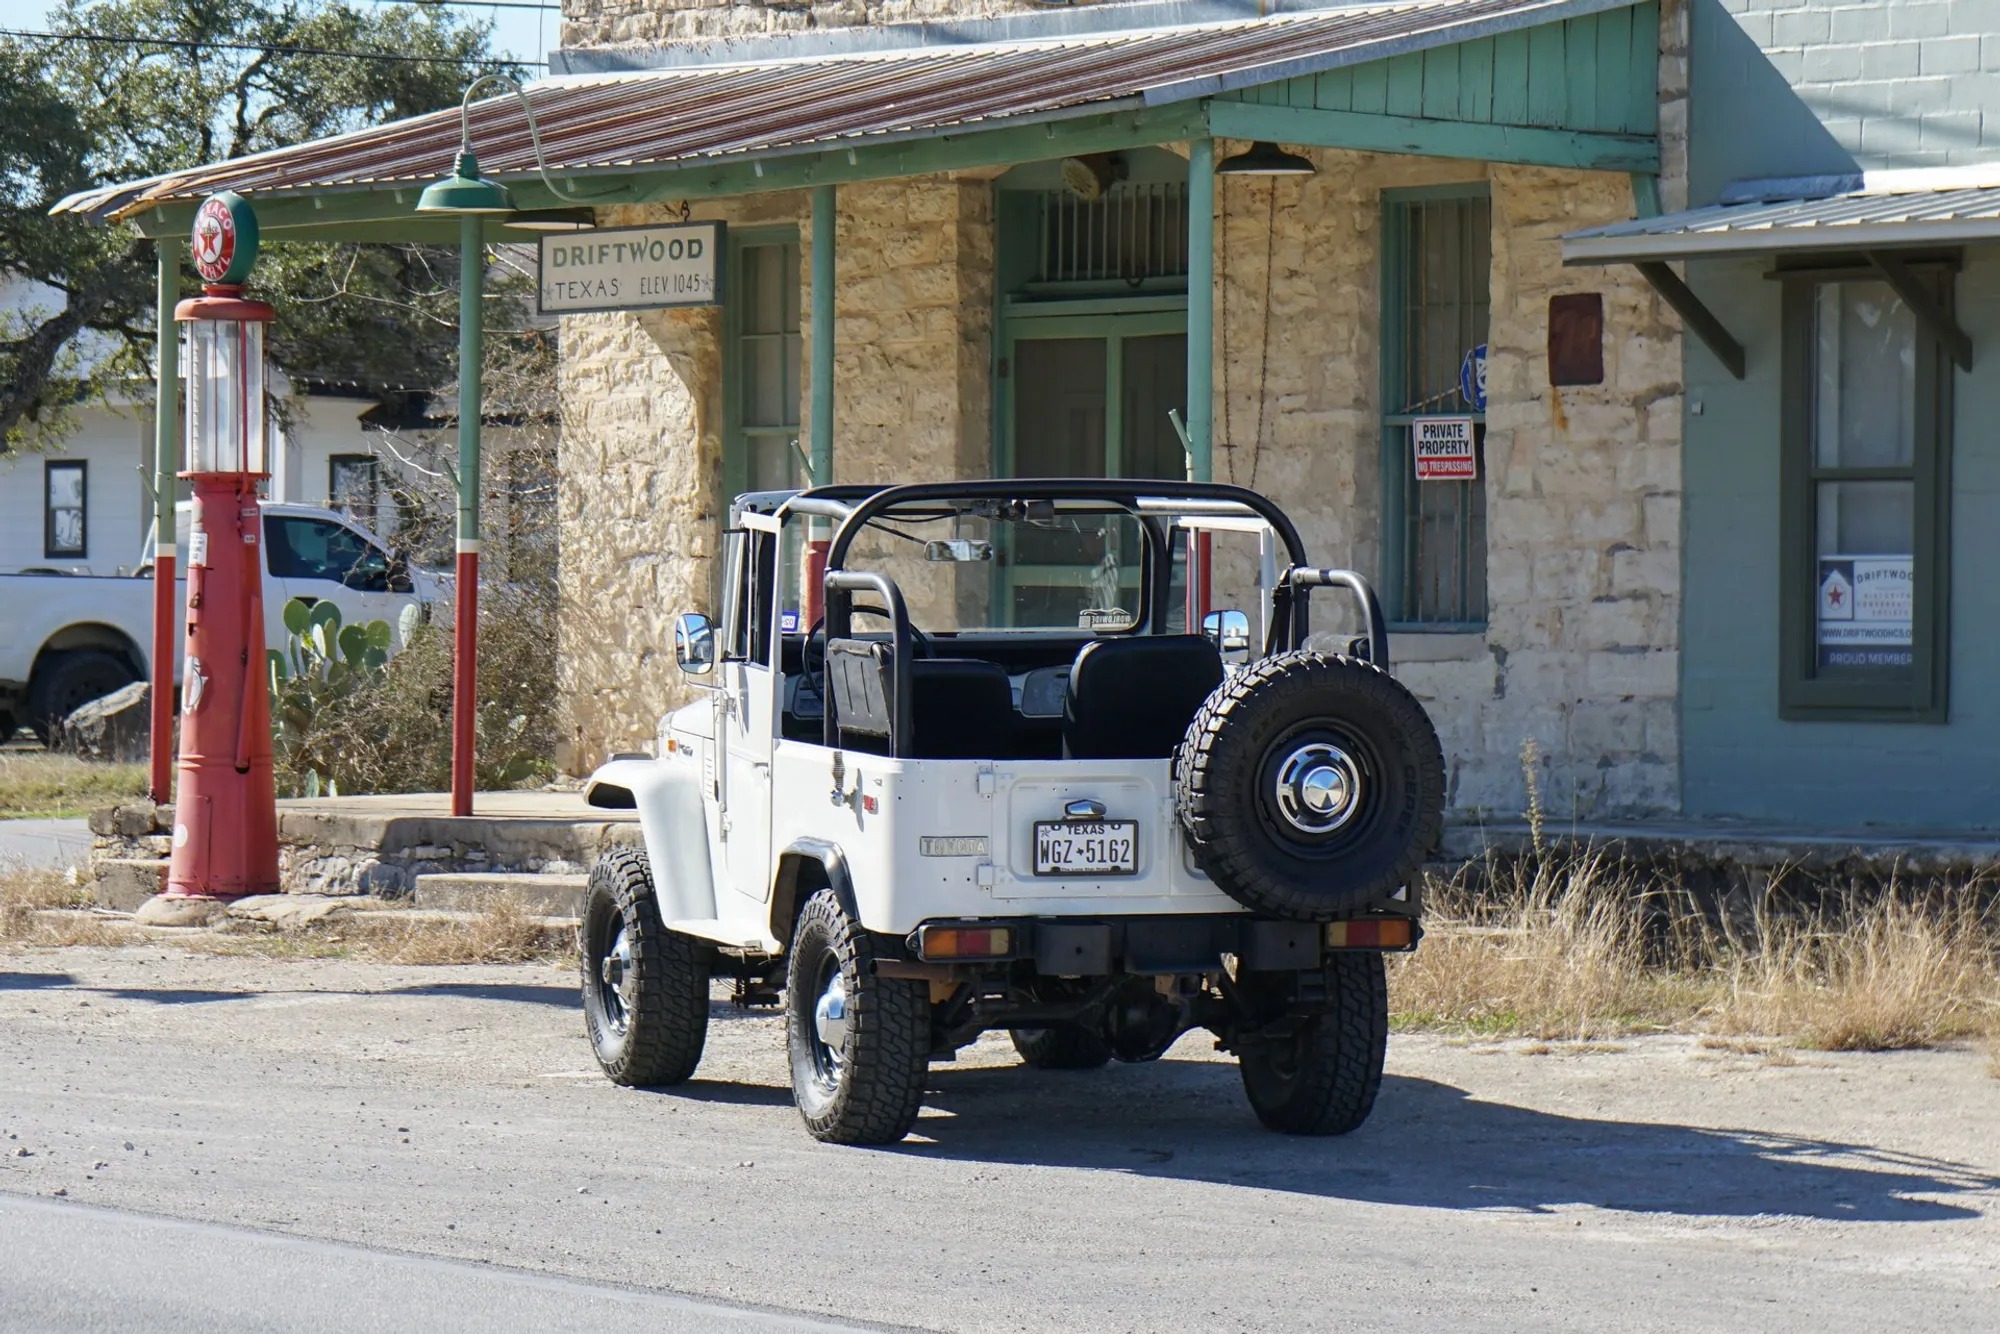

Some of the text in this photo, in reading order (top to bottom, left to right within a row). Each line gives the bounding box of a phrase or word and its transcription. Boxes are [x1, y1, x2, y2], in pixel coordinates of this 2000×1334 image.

[552, 236, 704, 268] DRIFTWOOD
[555, 273, 700, 300] TEXAS ELEV. 1045
[1423, 424, 1464, 438] PRIVATE
[1419, 440, 1469, 455] PROPERTY
[1418, 460, 1472, 472] NO TRESPASSING
[1829, 652, 1912, 665] PROUD MEMBER
[1066, 824, 1105, 835] TEXAS
[923, 838, 986, 854] TOYOTA
[1040, 839, 1131, 864] WGZ 5162
